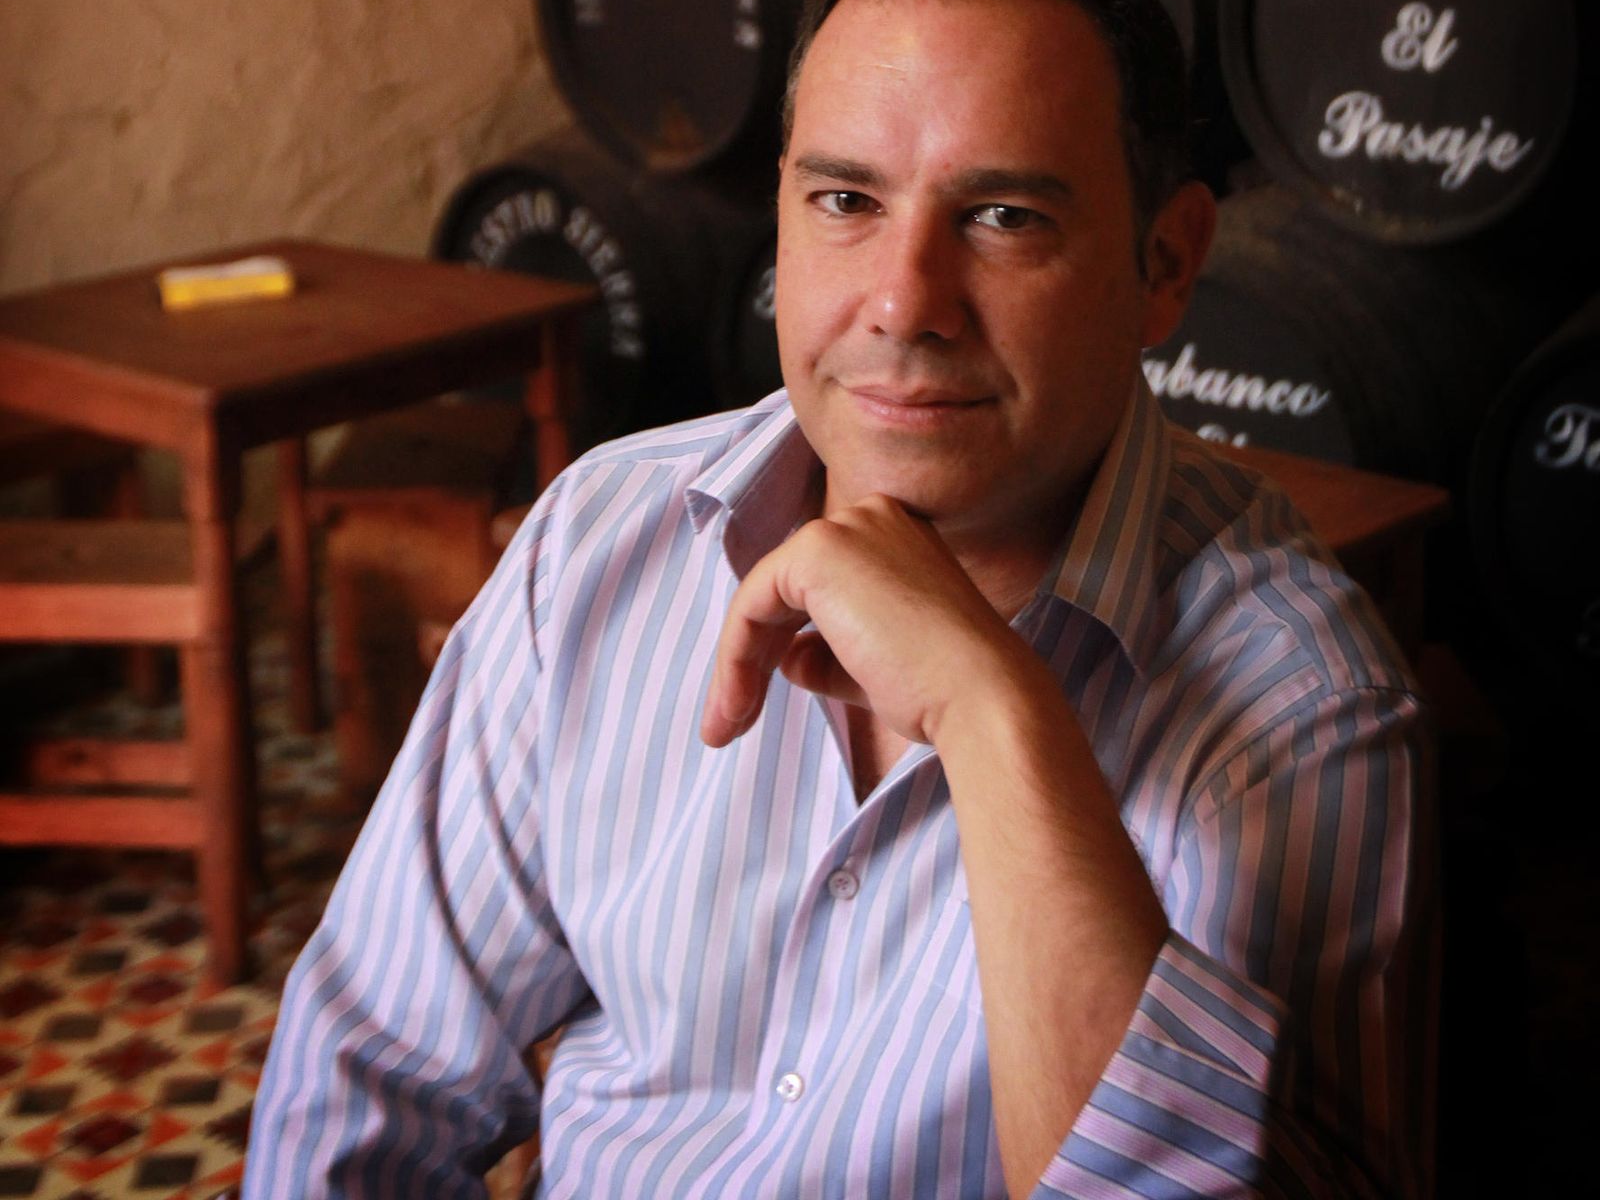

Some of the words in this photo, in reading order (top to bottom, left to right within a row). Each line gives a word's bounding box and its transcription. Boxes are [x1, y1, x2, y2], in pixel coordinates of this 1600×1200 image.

[1381, 2, 1458, 73] El
[1318, 91, 1535, 191] Pasaje
[1140, 342, 1331, 416] abanco
